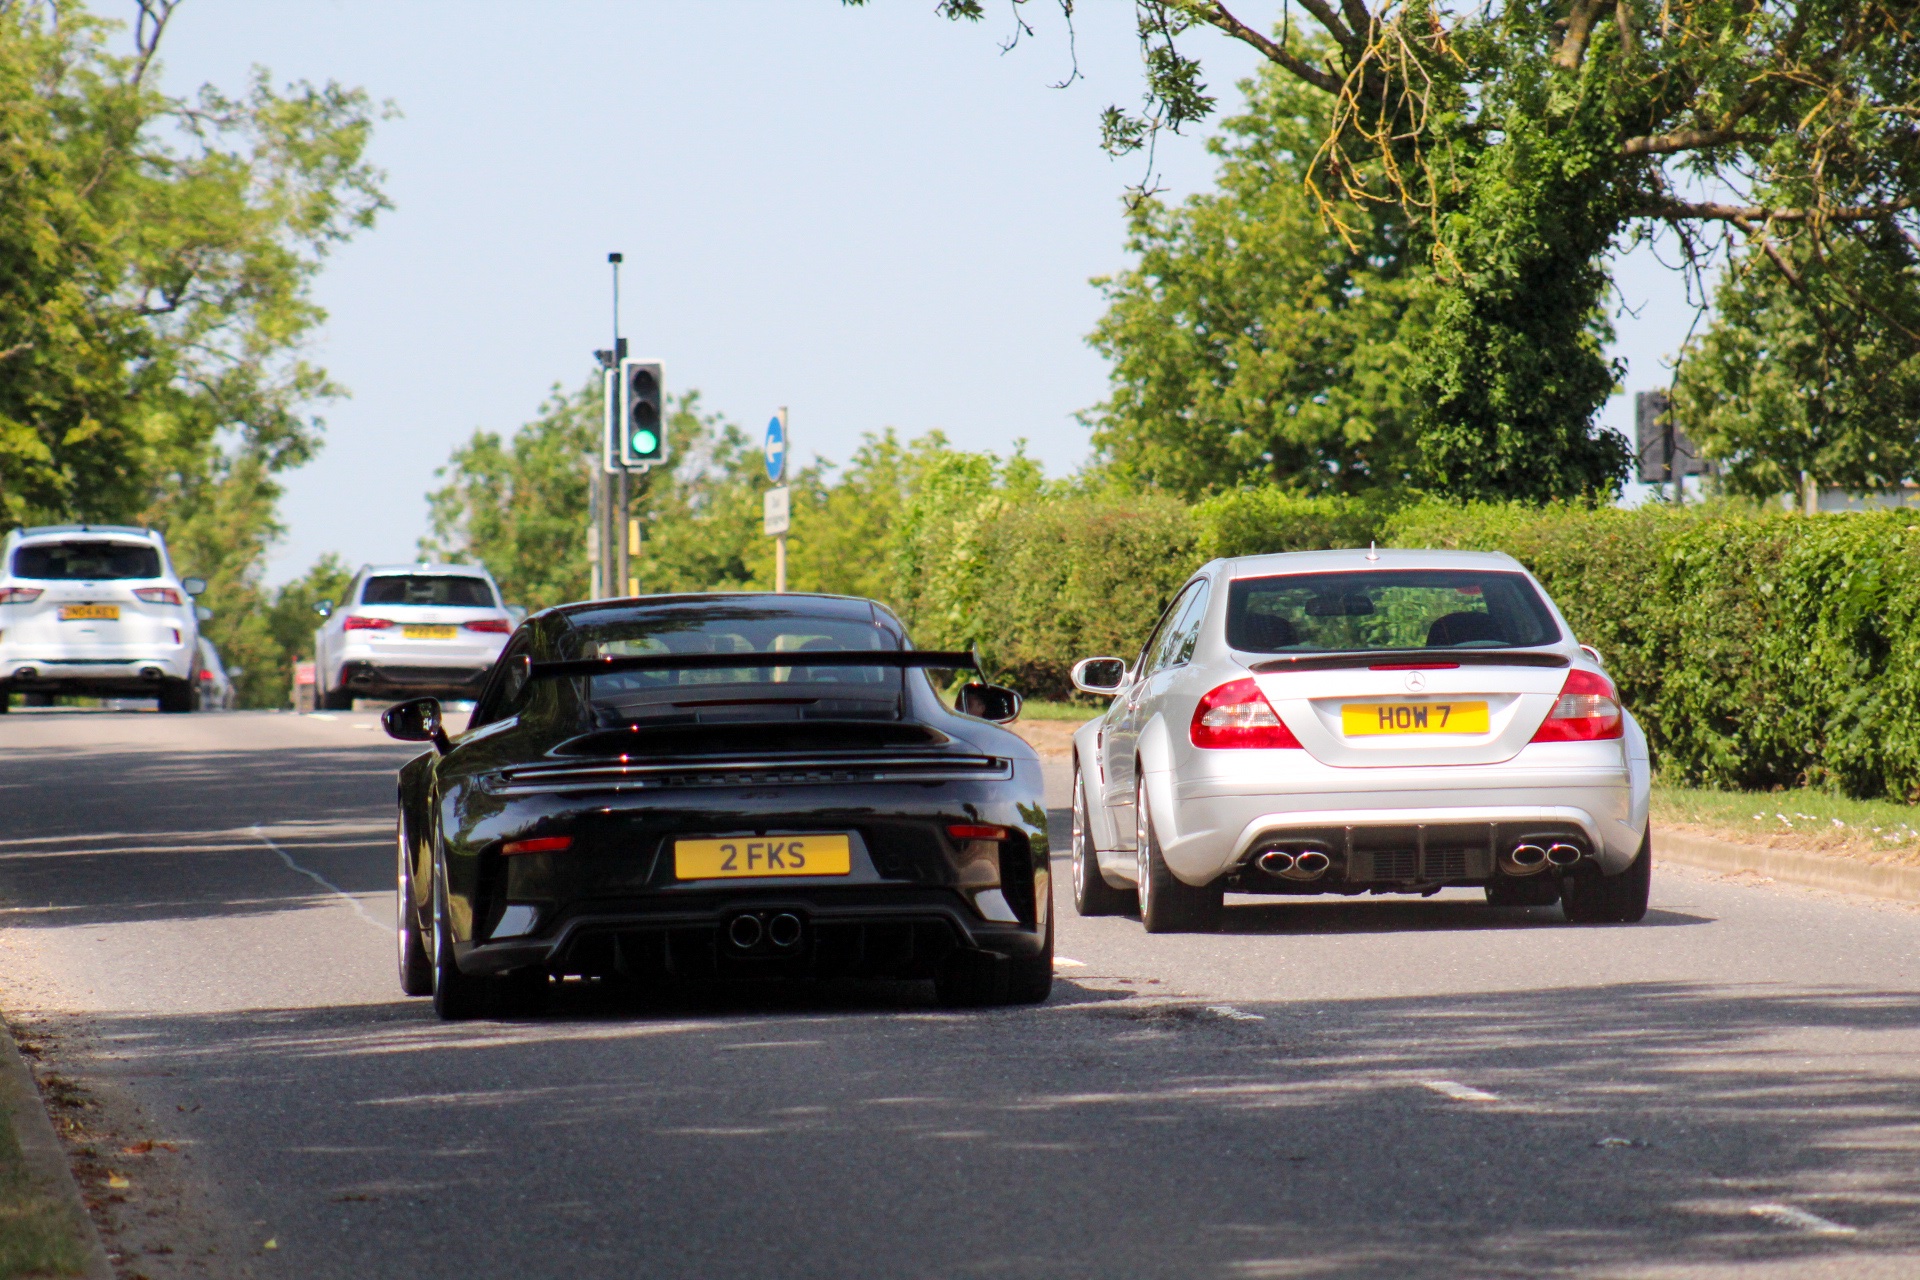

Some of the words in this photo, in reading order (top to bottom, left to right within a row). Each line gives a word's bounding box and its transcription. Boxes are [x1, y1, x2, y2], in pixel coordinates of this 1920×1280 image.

[1378, 706, 1428, 729] HOW
[1436, 705, 1451, 728] 7
[719, 844, 737, 871] 2
[747, 841, 806, 870] FKS
